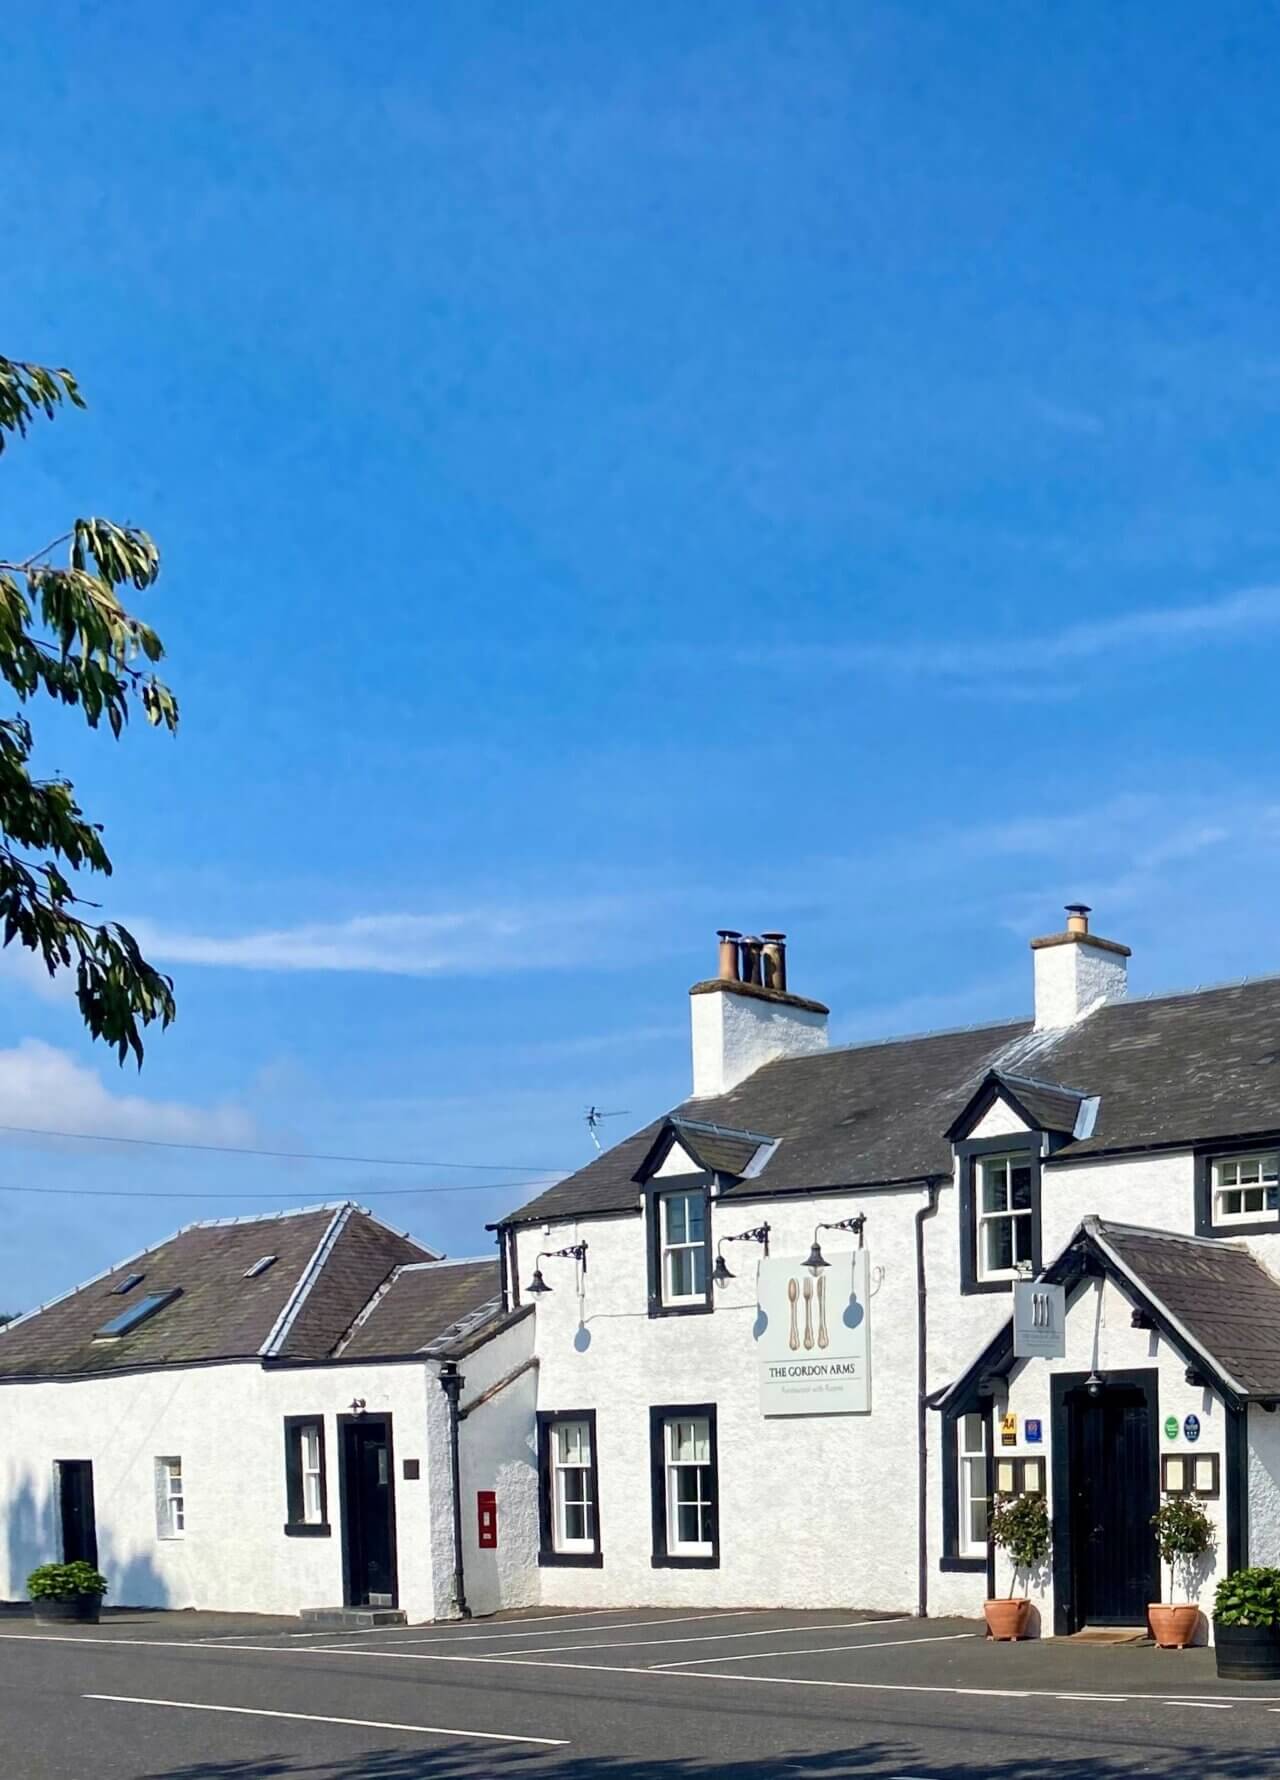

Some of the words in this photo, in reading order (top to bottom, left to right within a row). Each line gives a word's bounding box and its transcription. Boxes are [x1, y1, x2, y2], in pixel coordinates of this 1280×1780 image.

[769, 1367, 786, 1378] THE
[788, 1365, 828, 1377] GORDON
[829, 1363, 855, 1375] ARMS
